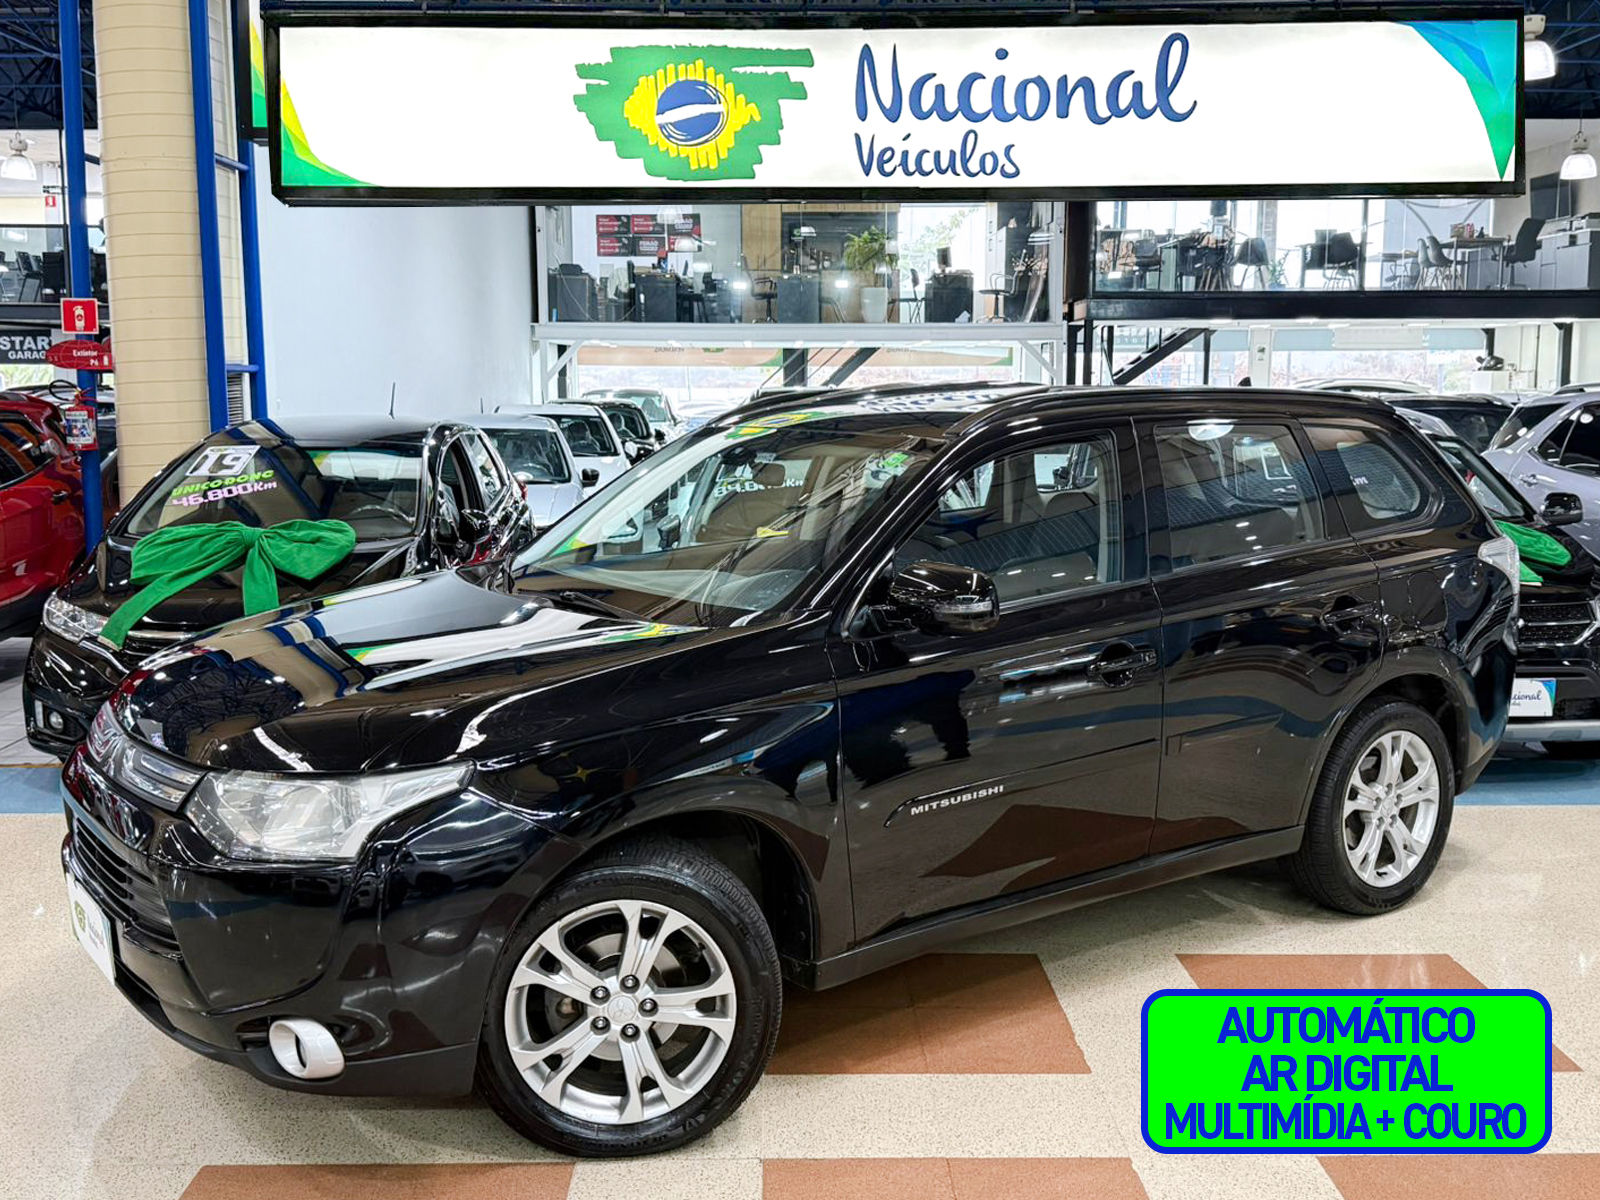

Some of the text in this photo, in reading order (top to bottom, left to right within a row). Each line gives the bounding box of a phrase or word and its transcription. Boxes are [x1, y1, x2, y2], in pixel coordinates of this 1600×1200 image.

[856, 33, 1197, 124] Nacional
[855, 130, 1020, 179] Veículos
[0, 336, 54, 350] STAR
[72, 349, 98, 357] Extintor
[7, 350, 47, 360] GARAG
[195, 449, 252, 475] 19
[1511, 690, 1542, 701] cional
[910, 785, 1005, 816] MITSUBISHI
